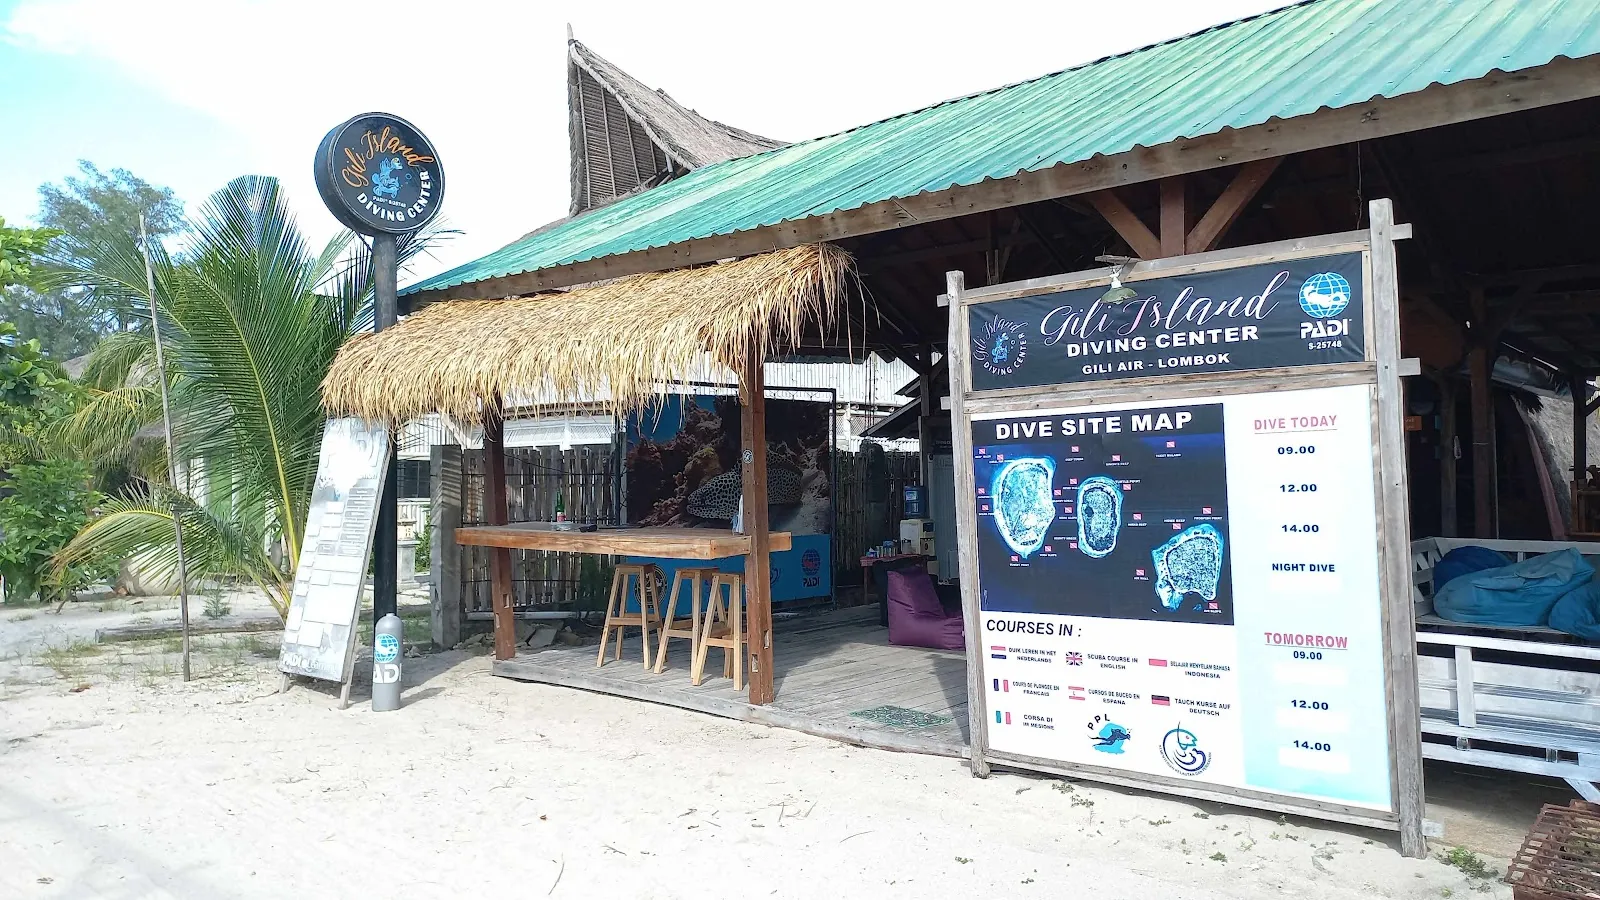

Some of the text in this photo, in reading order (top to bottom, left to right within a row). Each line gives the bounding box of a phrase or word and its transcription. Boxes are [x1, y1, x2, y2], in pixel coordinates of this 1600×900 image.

[342, 126, 434, 187] Gili Island
[357, 170, 432, 222] DIVING CENTER
[1040, 270, 1290, 346] Gili Island
[1300, 318, 1349, 340] PADI
[1067, 325, 1260, 358] DIVING CENTER
[1308, 340, 1342, 351] S-25748
[983, 332, 1028, 376] DIVING CENTER
[1082, 362, 1112, 375] GILI
[1117, 360, 1144, 372] AIR
[1158, 352, 1230, 369] LOMBOK
[995, 411, 1192, 440] DIVE SITE MAP
[1254, 414, 1338, 431] DIVE TODAY
[1277, 445, 1316, 455] 09.00
[1279, 483, 1318, 493] 12.00
[1281, 524, 1320, 533] 14.00
[1272, 563, 1336, 573] NIGHT DIVE
[802, 577, 820, 587] PADI
[986, 619, 1054, 636] COURSES
[1058, 623, 1074, 637] IN
[1264, 632, 1348, 649] TOMORROW
[1016, 655, 1052, 664] NEDERLANDS
[1087, 653, 1106, 661] SCUBA
[1107, 655, 1131, 663] COURSE
[1293, 650, 1323, 661] 09.00
[373, 663, 402, 684] ADI
[1185, 670, 1221, 679] INDONESIA
[1088, 688, 1107, 696] CURSOS
[1115, 691, 1133, 699] BUCEO
[1174, 698, 1195, 706] TAUCH
[1196, 700, 1218, 709] KURSE
[1290, 699, 1329, 711] 12.00
[1023, 714, 1045, 722] CORSA
[1189, 708, 1220, 717] DEUTSCH
[1293, 740, 1332, 752] 14.00
